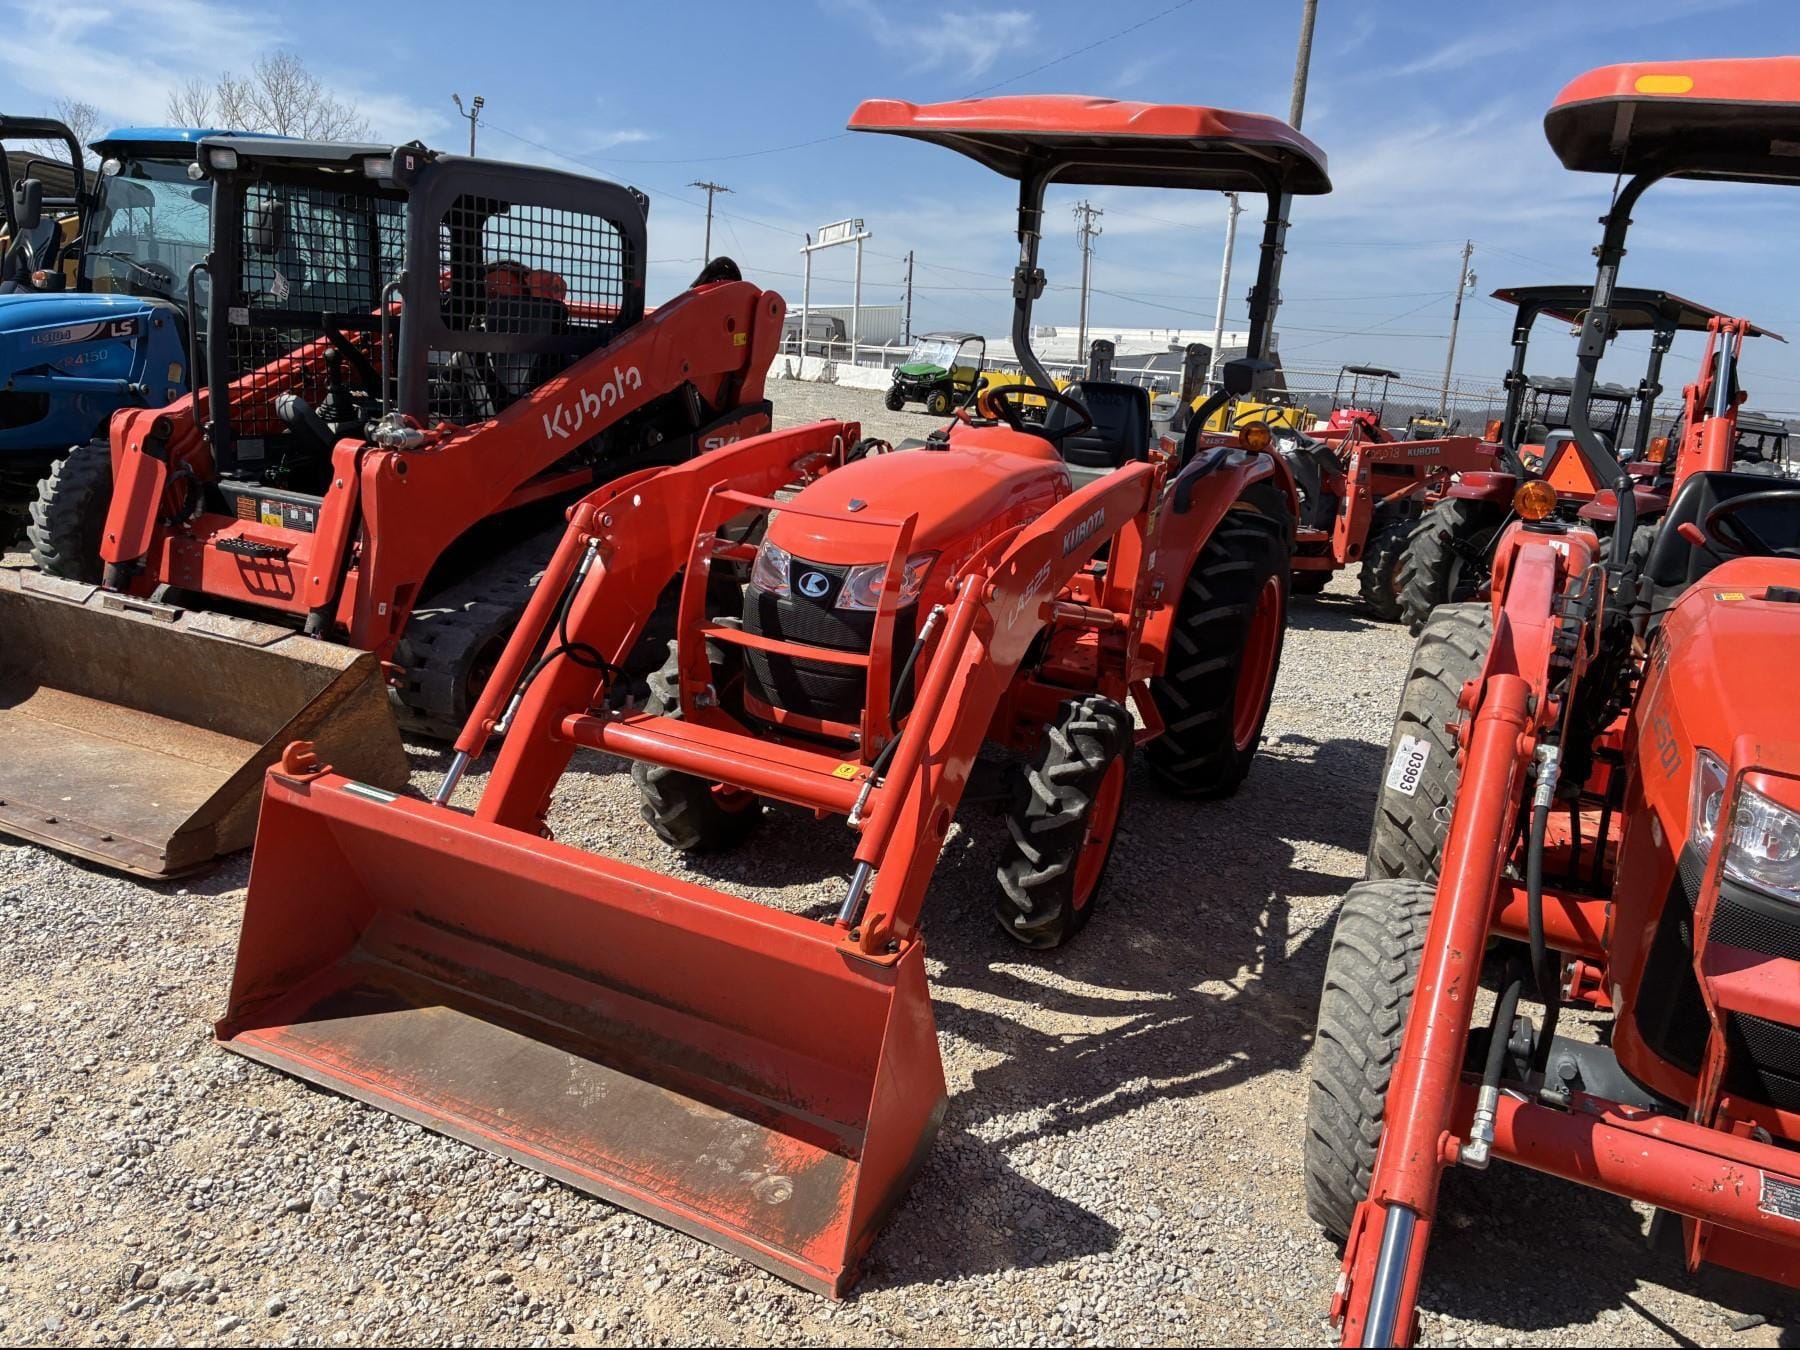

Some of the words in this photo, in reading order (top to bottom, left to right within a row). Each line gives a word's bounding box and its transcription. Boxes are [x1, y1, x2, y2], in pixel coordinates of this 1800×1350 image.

[111, 319, 135, 337] LS
[542, 366, 642, 439] Kubota
[1407, 446, 1440, 457] KUBOTA
[1063, 507, 1105, 556] KUBOTA
[1008, 559, 1052, 631] LA525
[1399, 752, 1424, 791] 03993
